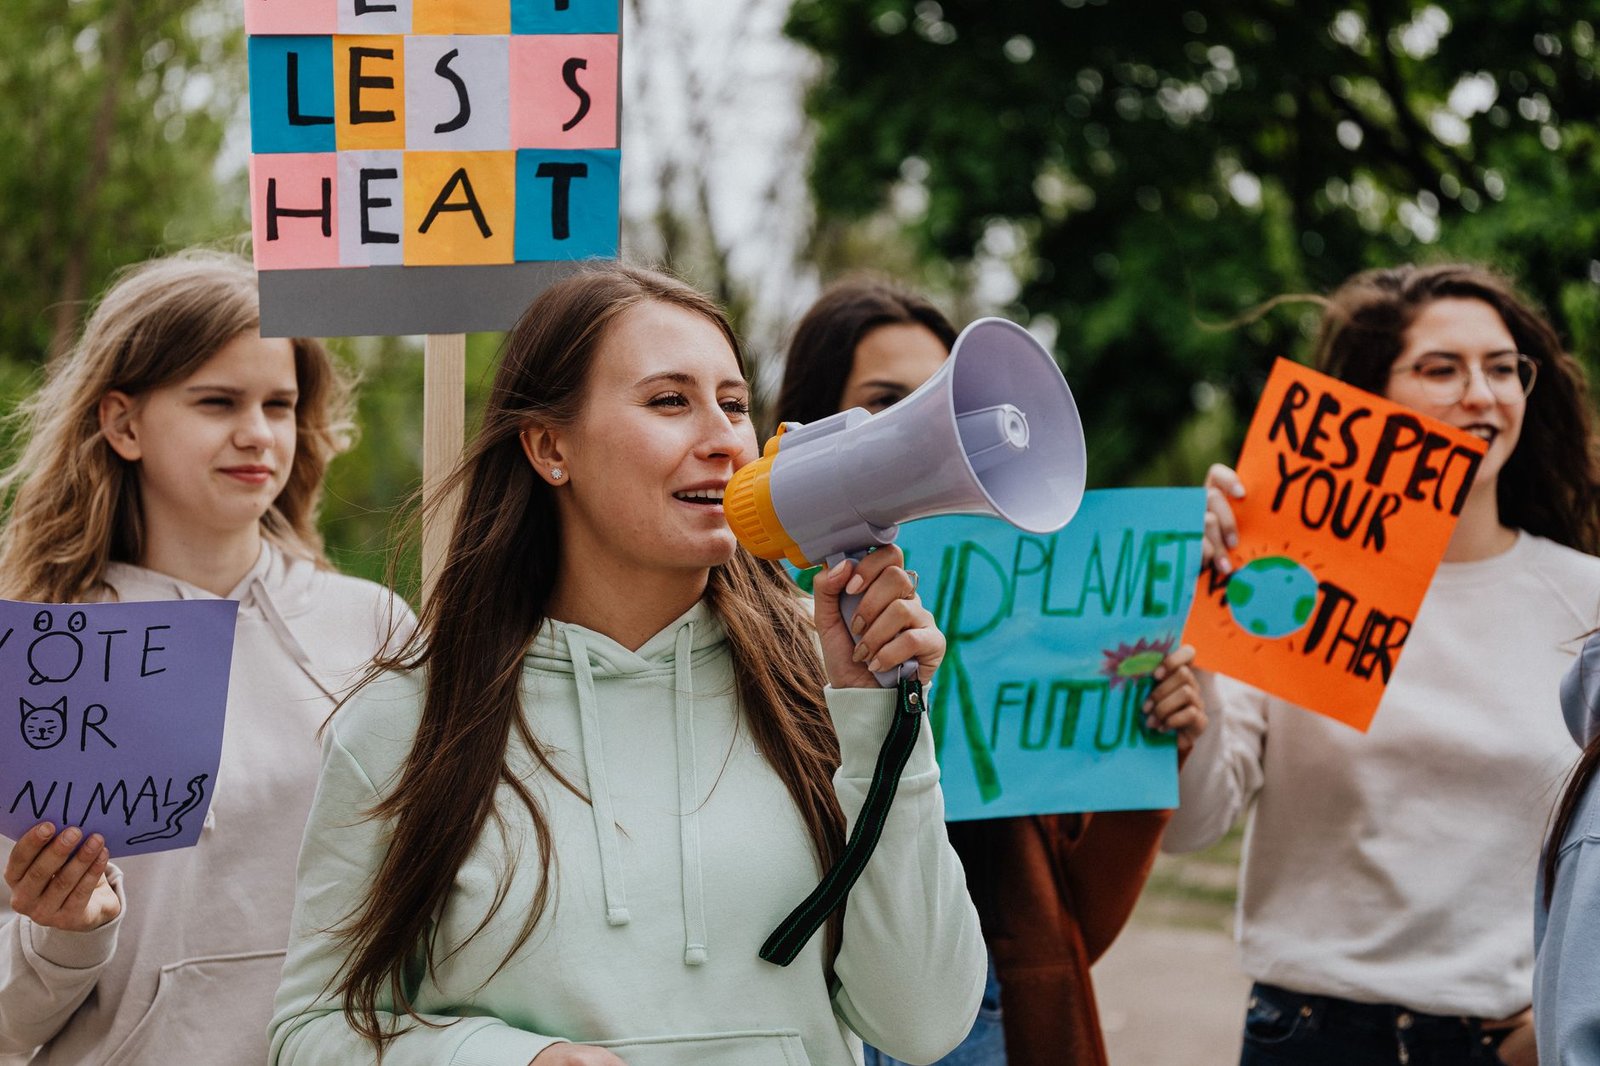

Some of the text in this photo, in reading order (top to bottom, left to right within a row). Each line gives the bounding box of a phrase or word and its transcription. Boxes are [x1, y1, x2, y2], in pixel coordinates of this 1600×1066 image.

[286, 46, 591, 134] LESS
[266, 162, 588, 244] HEAT
[1271, 453, 1403, 553] YOUR
[1008, 530, 1203, 618] PLANET
[0, 773, 208, 846] NIMALS
